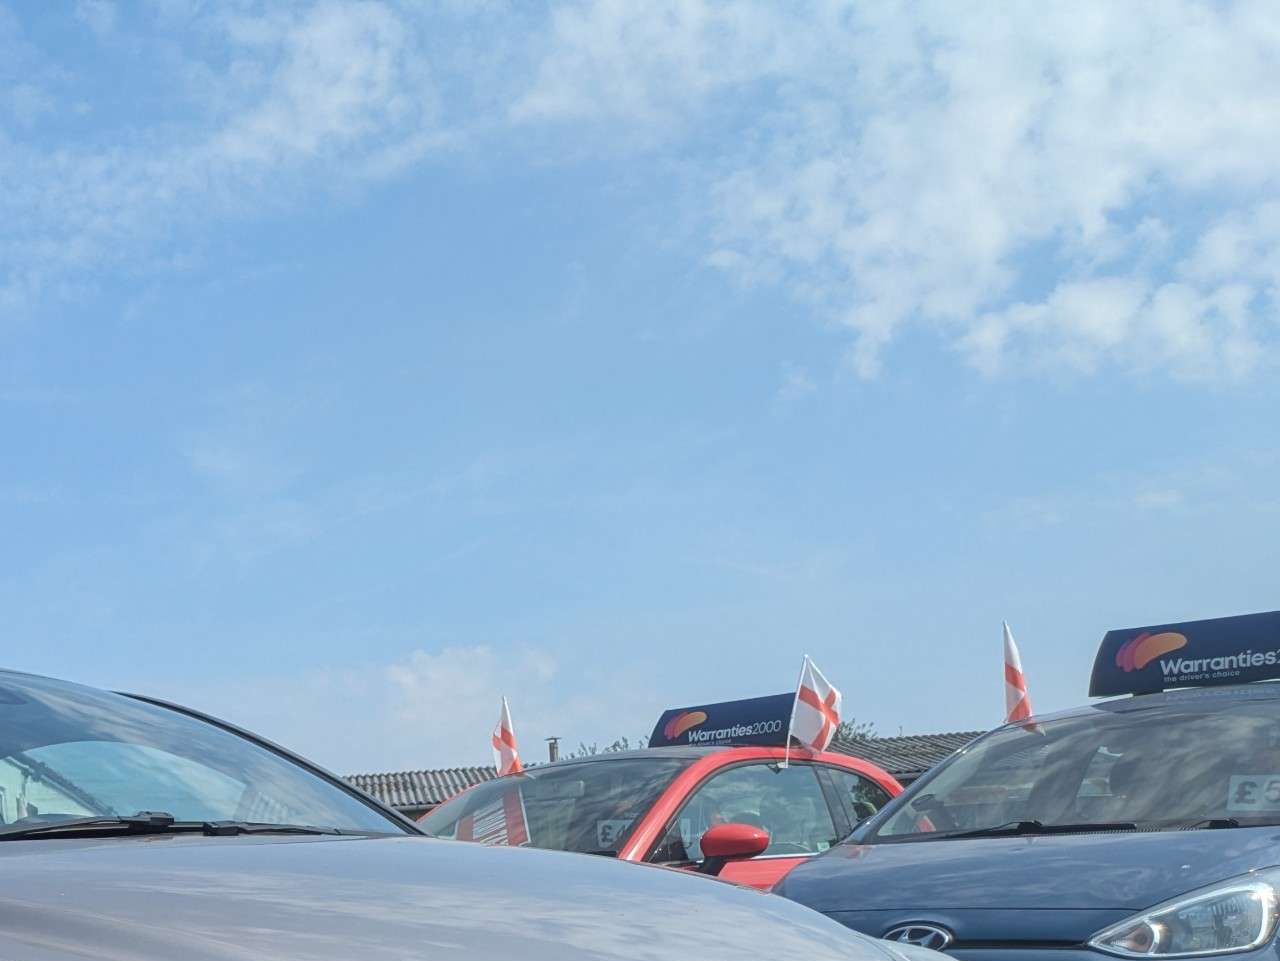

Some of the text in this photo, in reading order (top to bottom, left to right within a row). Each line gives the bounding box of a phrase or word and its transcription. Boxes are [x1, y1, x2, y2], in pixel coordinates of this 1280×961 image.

[1160, 648, 1280, 676] Warranties
[1212, 670, 1241, 679] choice
[688, 719, 782, 742] Warranties2000
